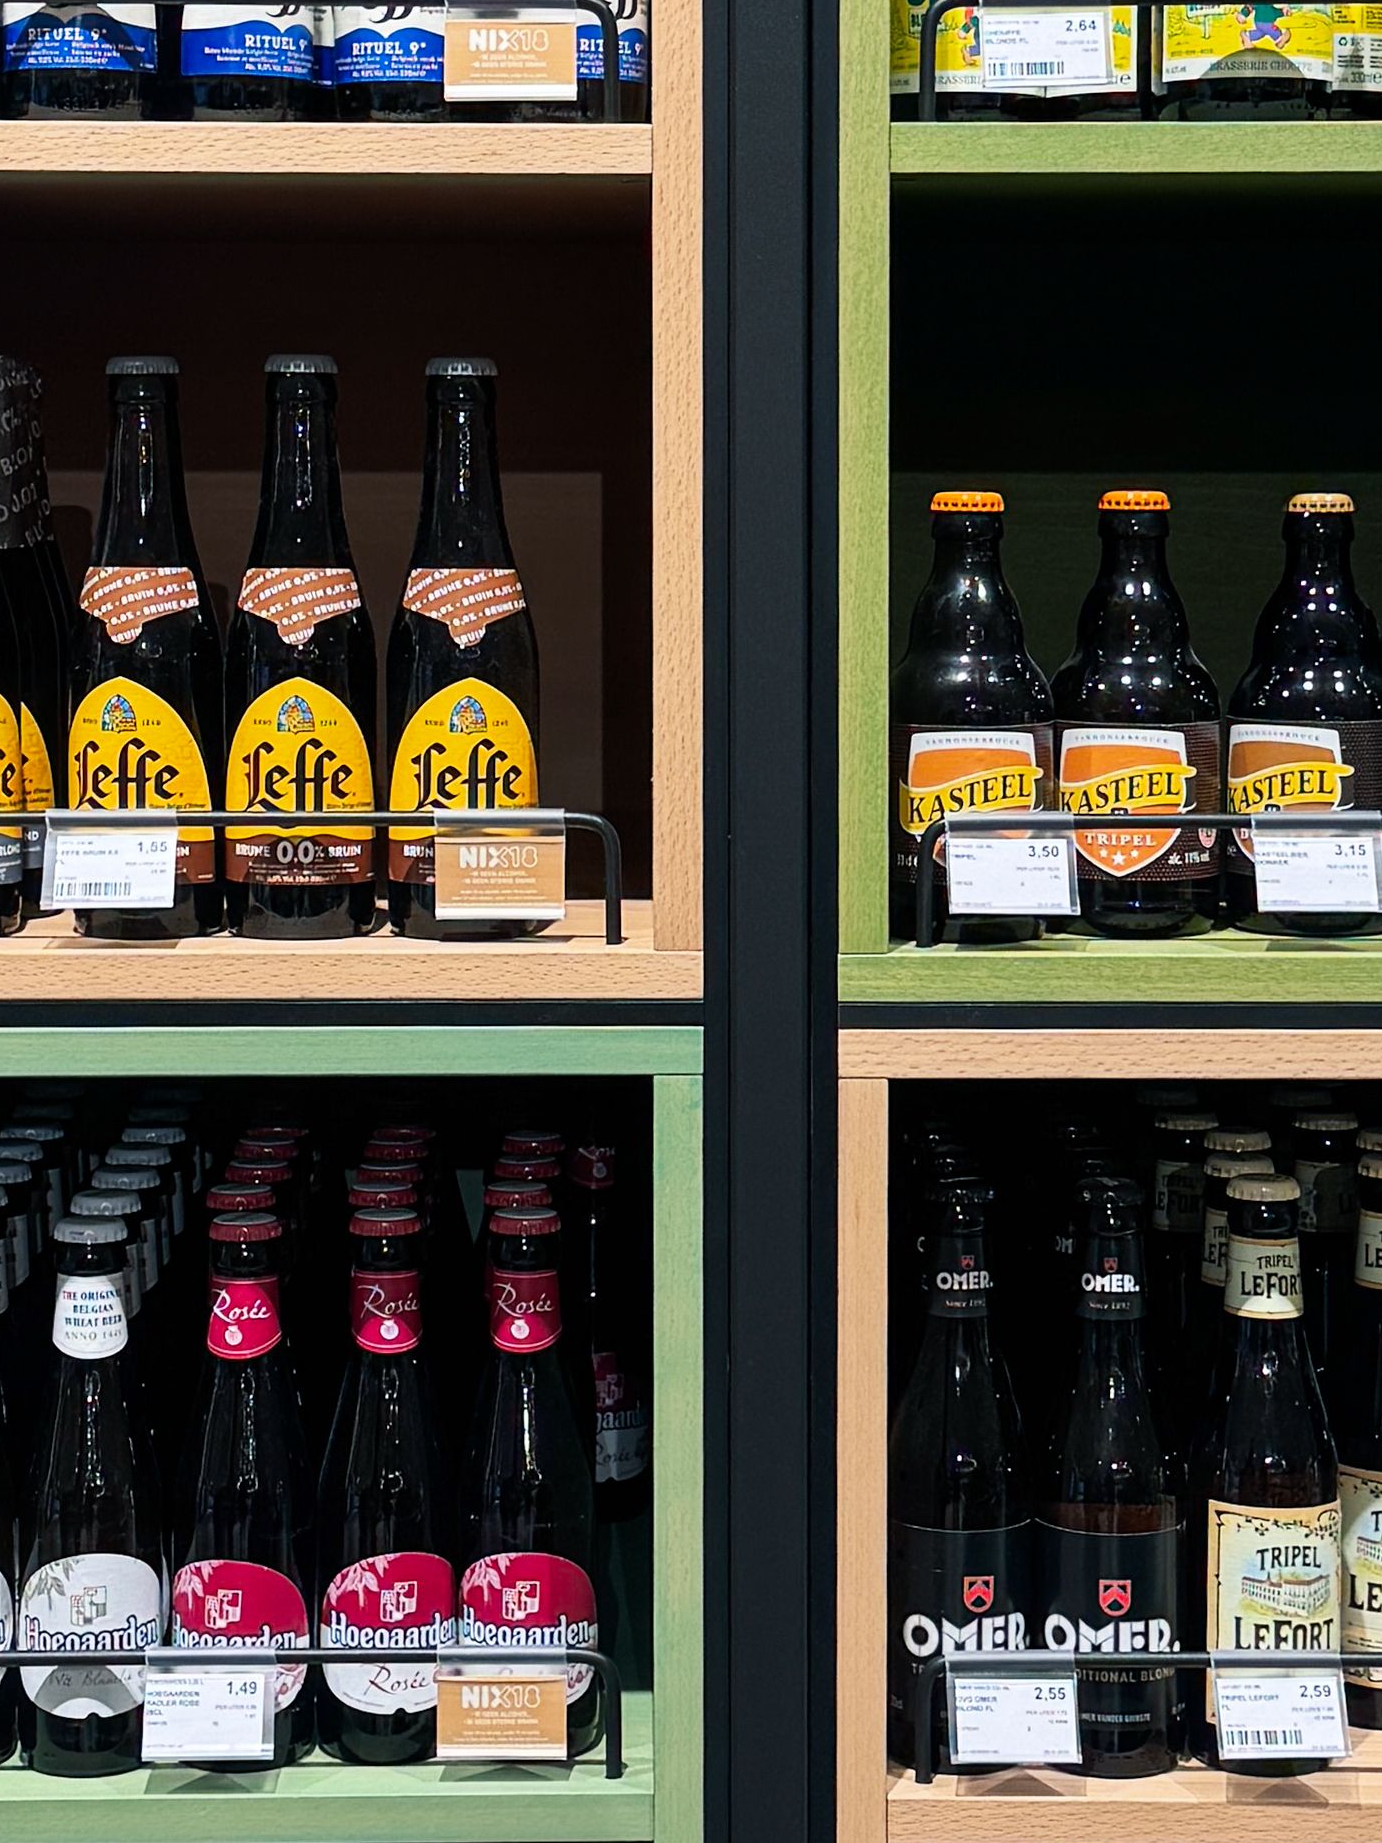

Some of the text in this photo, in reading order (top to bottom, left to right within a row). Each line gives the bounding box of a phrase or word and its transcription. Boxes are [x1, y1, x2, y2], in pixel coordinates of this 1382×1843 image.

[1064, 19, 1098, 32] 2,64
[244, 33, 295, 49] RITUEL
[352, 40, 403, 56] RITUEL
[468, 28, 549, 53] NIX18
[908, 771, 1032, 824] KASTEEL
[1060, 770, 1182, 816] KASTEEL
[235, 841, 362, 858] BRUNE BRUIN
[1085, 833, 1156, 847] TRIPEL
[1334, 844, 1367, 858] 3,15
[458, 844, 539, 871] NIX18
[1027, 845, 1060, 859] 3,50
[1256, 1253, 1295, 1269] TRIPEL
[1081, 1271, 1141, 1293] OMER.
[212, 1288, 272, 1322] Rosée
[493, 1282, 554, 1318] Rosée
[1256, 1545, 1322, 1571] TRIPEL
[24, 1612, 157, 1653] Hoegaarden
[329, 1608, 457, 1649] Hoegaarden
[462, 1606, 590, 1648] Hoegaarden
[1235, 1616, 1334, 1651] LEFORT
[225, 1681, 258, 1696] 1,49
[460, 1684, 541, 1710] NIX18
[1033, 1687, 1067, 1701] 2,55
[1299, 1685, 1332, 1699] 2,59
